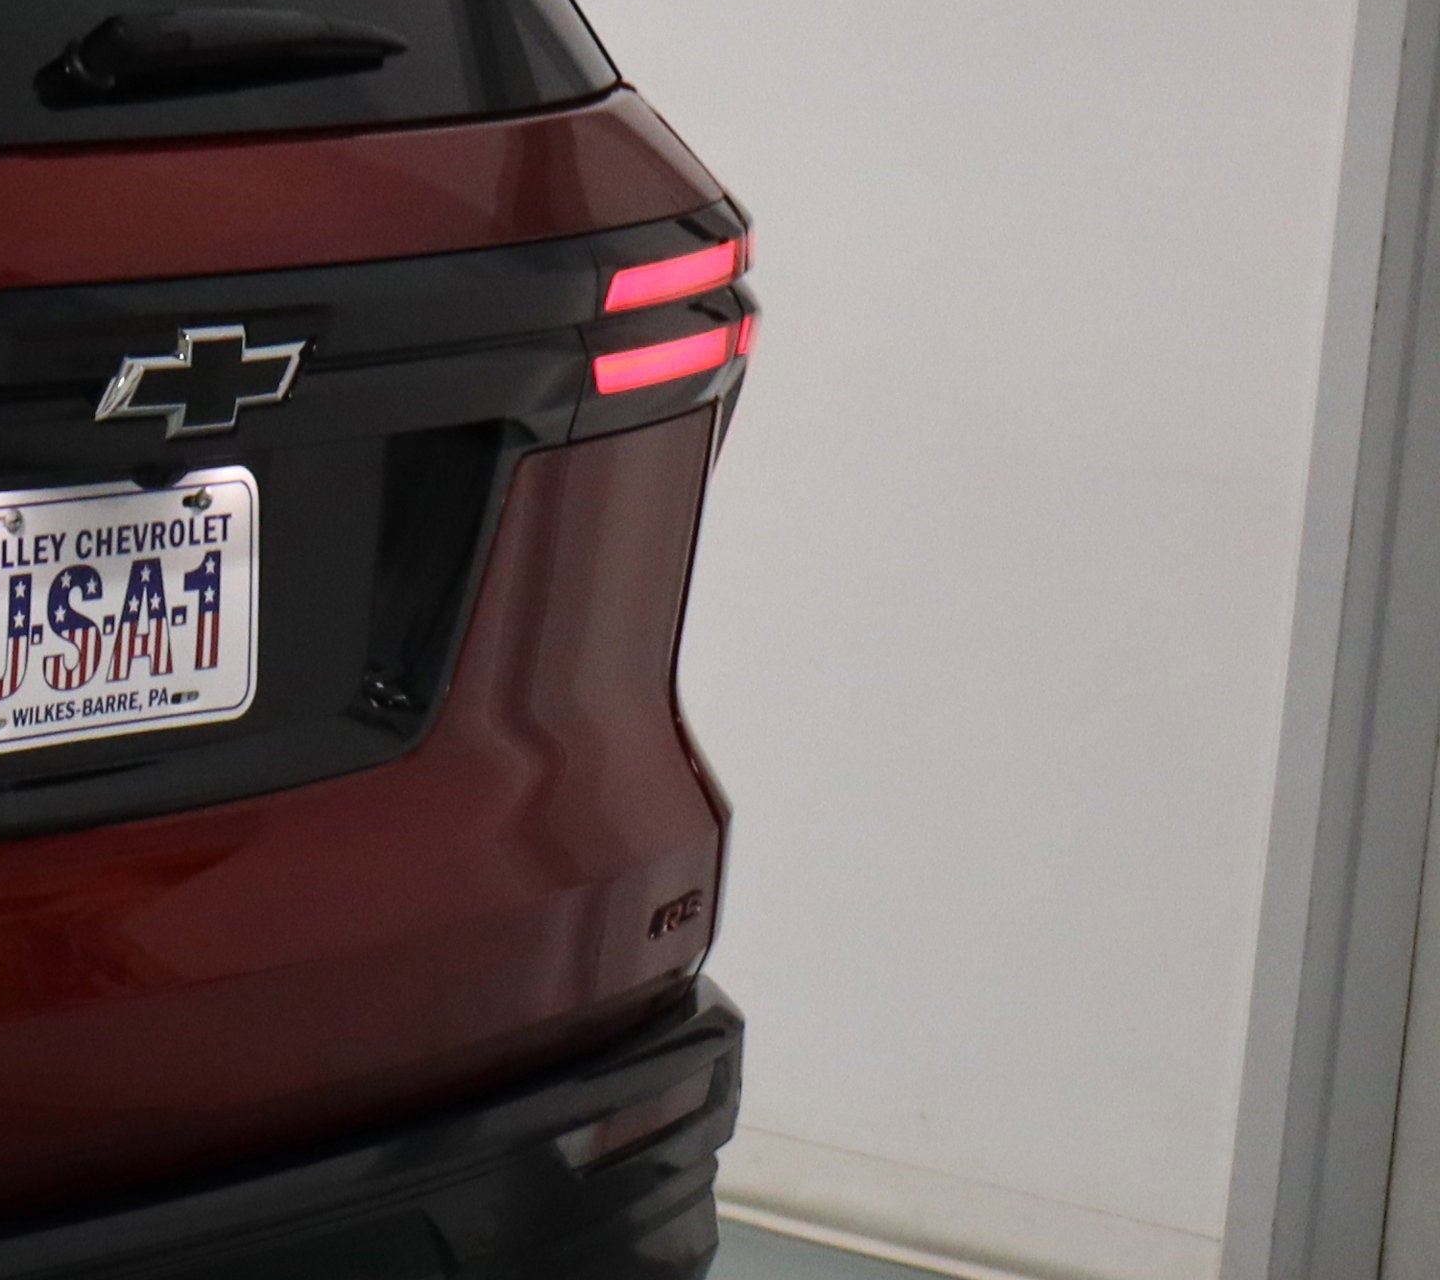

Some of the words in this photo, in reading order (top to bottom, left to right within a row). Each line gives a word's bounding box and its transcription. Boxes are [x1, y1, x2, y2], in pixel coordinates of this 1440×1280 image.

[75, 513, 233, 559] CHEVROLET
[12, 692, 143, 728] WILKES-BARRE,
[148, 686, 169, 708] PA
